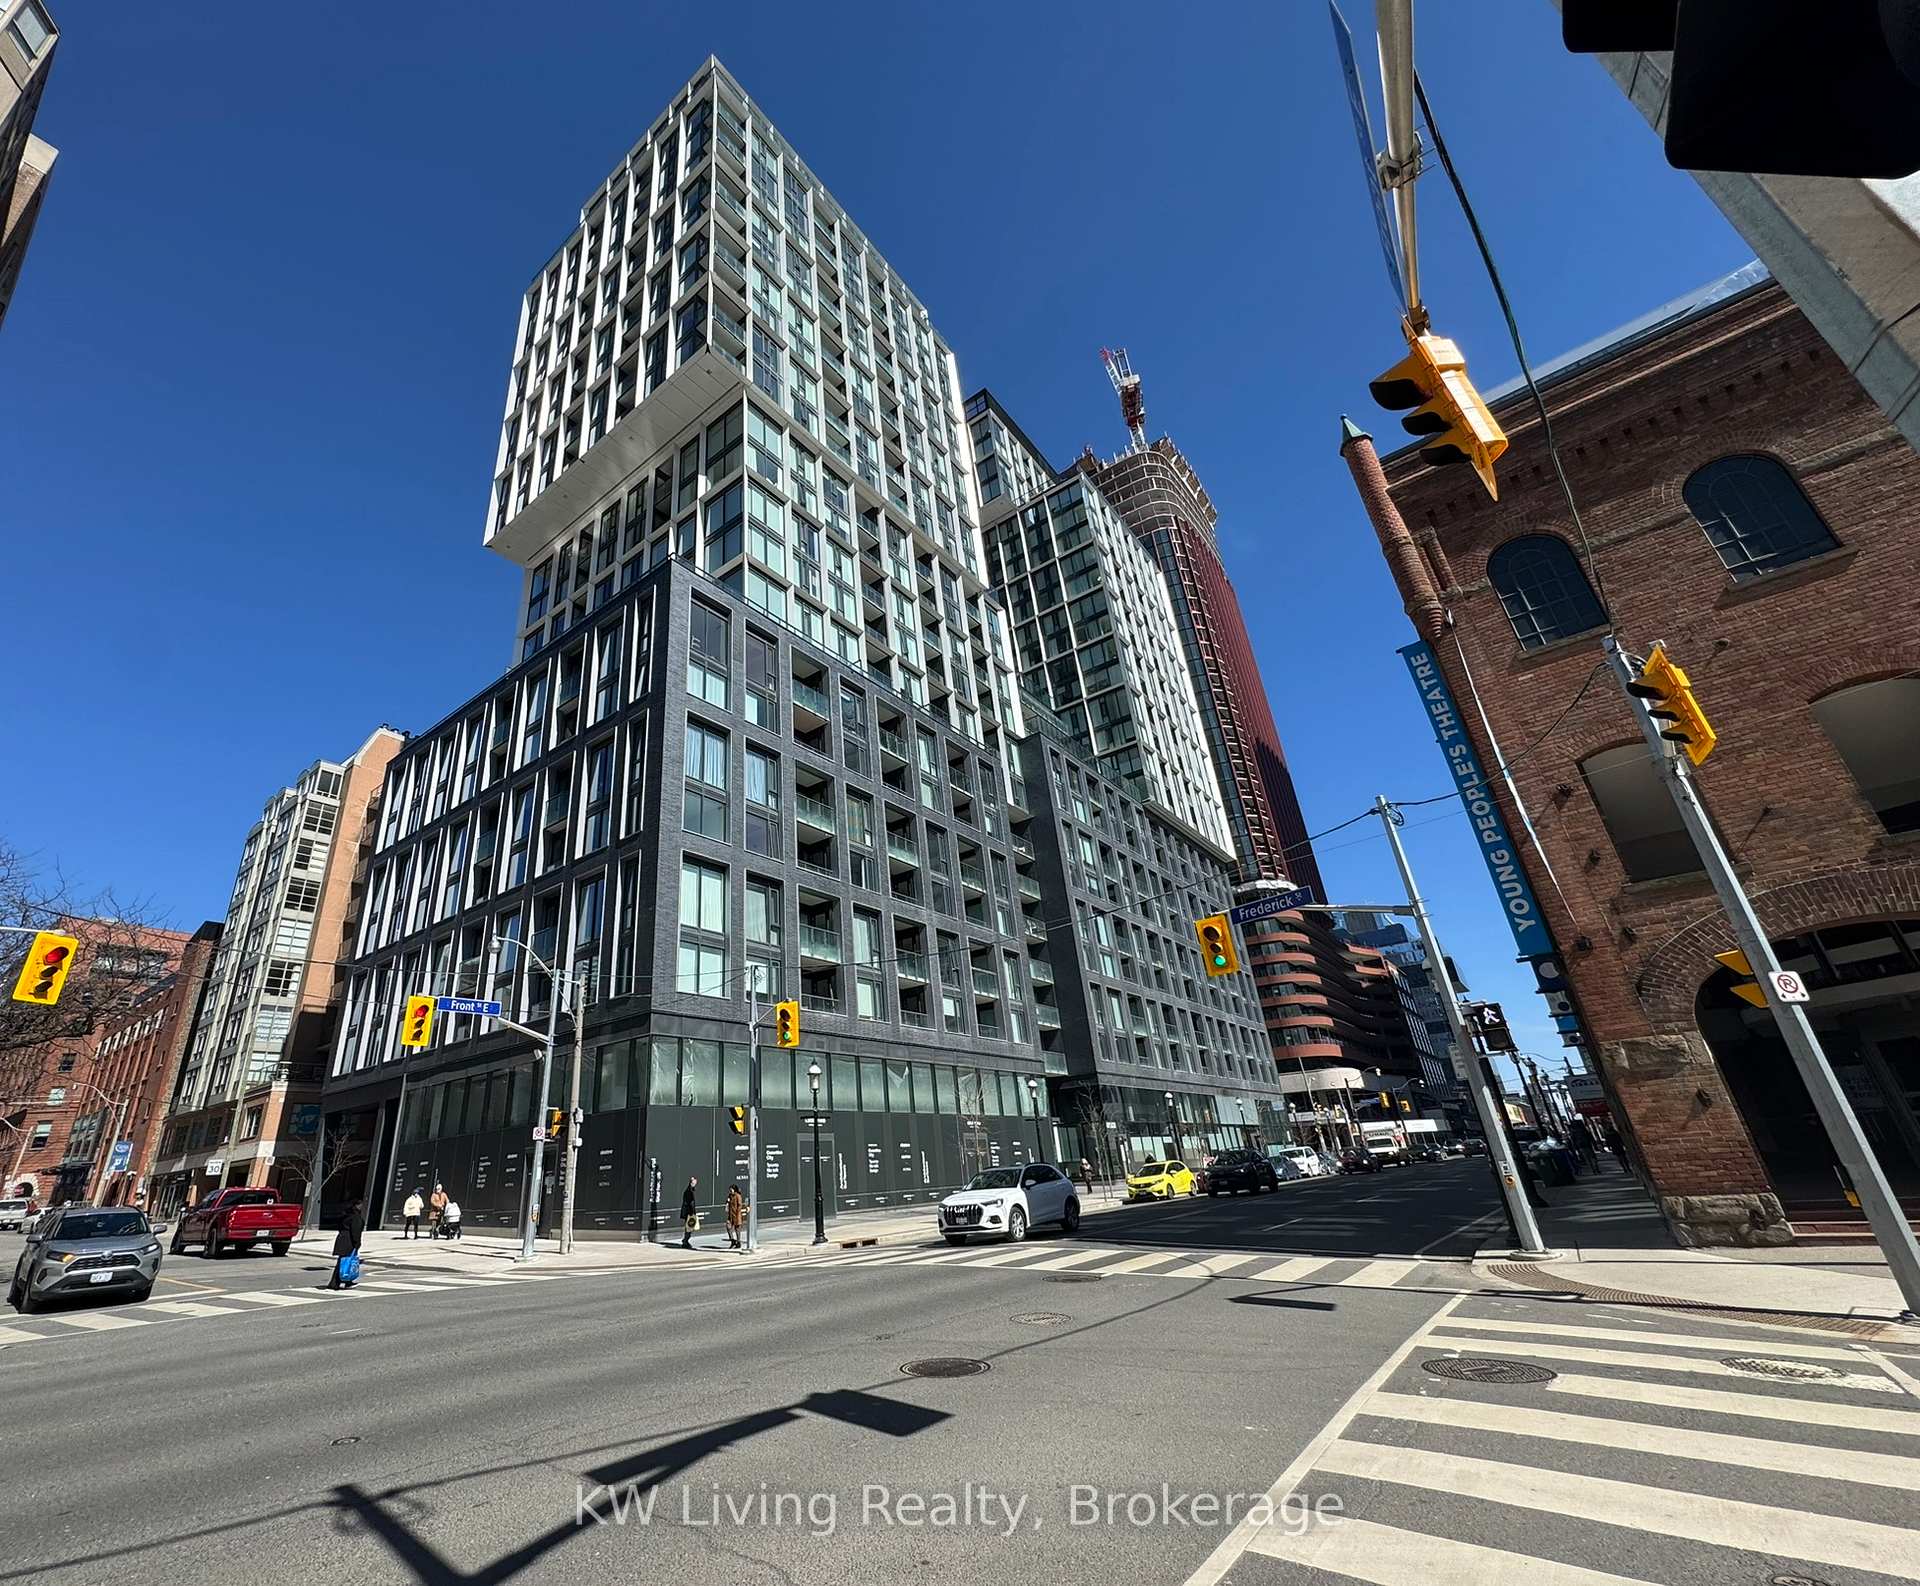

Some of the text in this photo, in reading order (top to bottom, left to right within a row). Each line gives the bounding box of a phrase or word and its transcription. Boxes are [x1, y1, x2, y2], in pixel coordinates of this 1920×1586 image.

[1410, 652, 1536, 933] YOUNG PEOPLE'S THEATRE
[1239, 896, 1294, 920] Frederick
[450, 1000, 475, 1011] Front
[483, 1003, 489, 1013] E
[207, 1165, 220, 1173] 30
